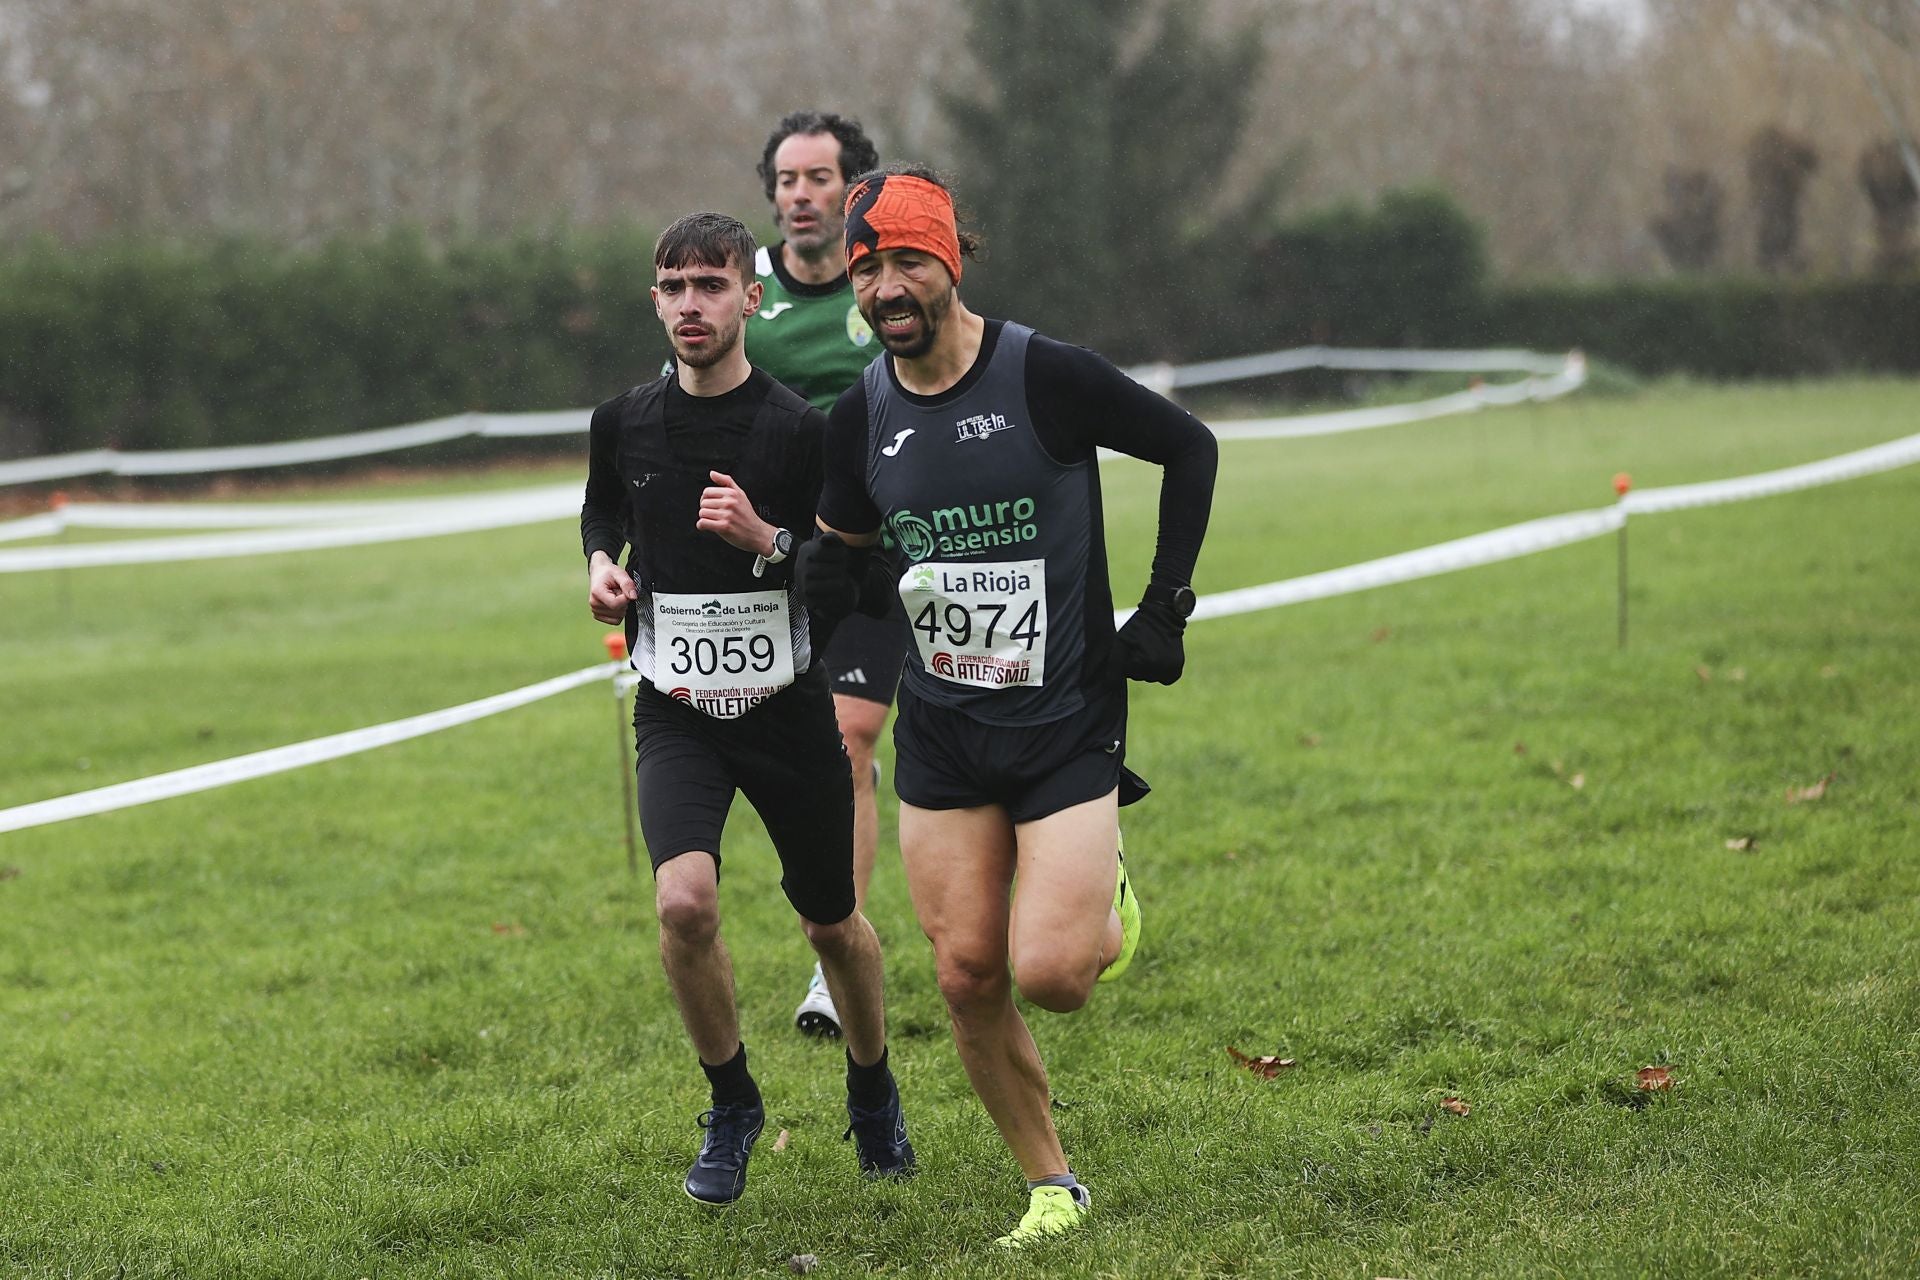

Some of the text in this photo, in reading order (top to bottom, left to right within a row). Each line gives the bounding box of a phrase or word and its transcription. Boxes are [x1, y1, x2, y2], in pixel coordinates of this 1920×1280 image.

[932, 497, 1035, 533] muro
[939, 520, 1038, 552] asensio
[943, 570, 1031, 595] La Rioja
[659, 603, 779, 615] Gobierno de La Rioja
[914, 599, 1041, 652] 4974
[670, 634, 775, 676] 3059
[995, 657, 1020, 668] RIOJANA
[1021, 659, 1031, 667] DE
[957, 663, 1030, 684] ATLETISMO
[695, 686, 741, 698] FEDERACIÓN
[743, 686, 775, 697] RIOJANA
